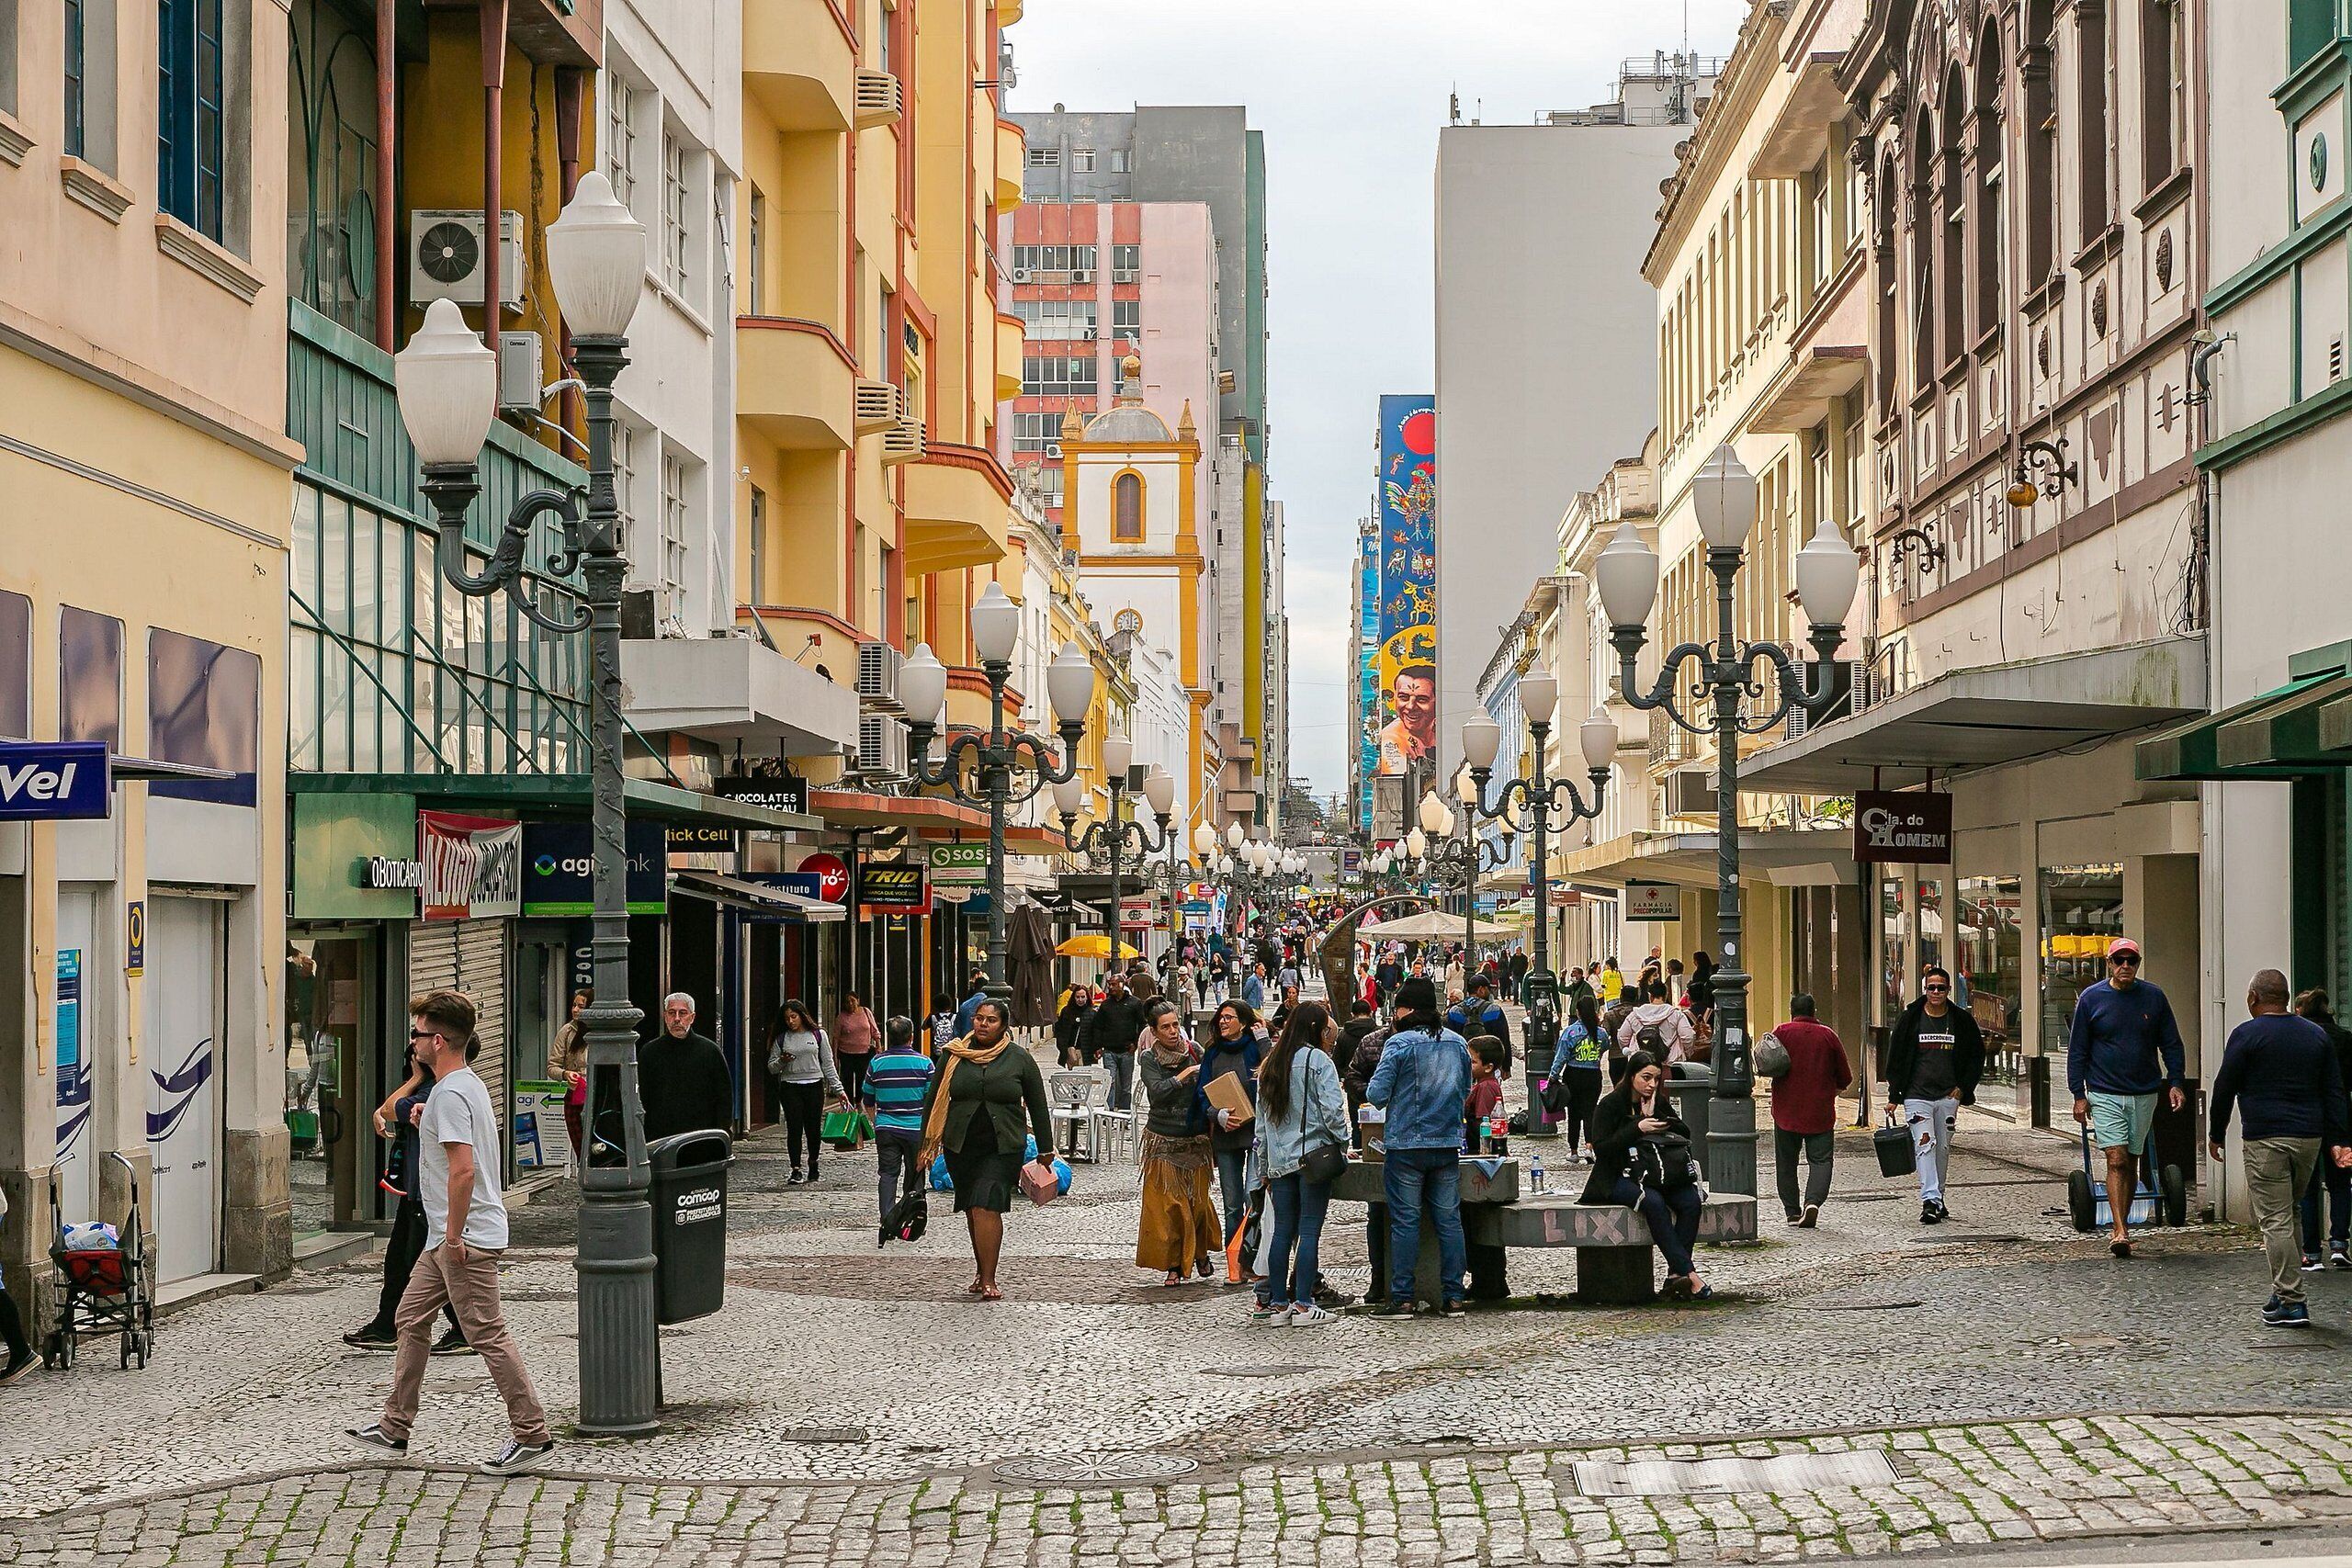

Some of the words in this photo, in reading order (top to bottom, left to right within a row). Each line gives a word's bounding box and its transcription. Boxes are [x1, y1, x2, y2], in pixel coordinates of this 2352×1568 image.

[724, 793, 797, 804] OCOLATES
[1906, 814, 1924, 826] do
[666, 829, 694, 841] lick
[697, 829, 729, 841] Cell
[1868, 824, 1946, 848] HOMEM
[425, 834, 478, 908] ALUGO
[865, 870, 919, 884] TRID
[516, 1095, 535, 1107] agi
